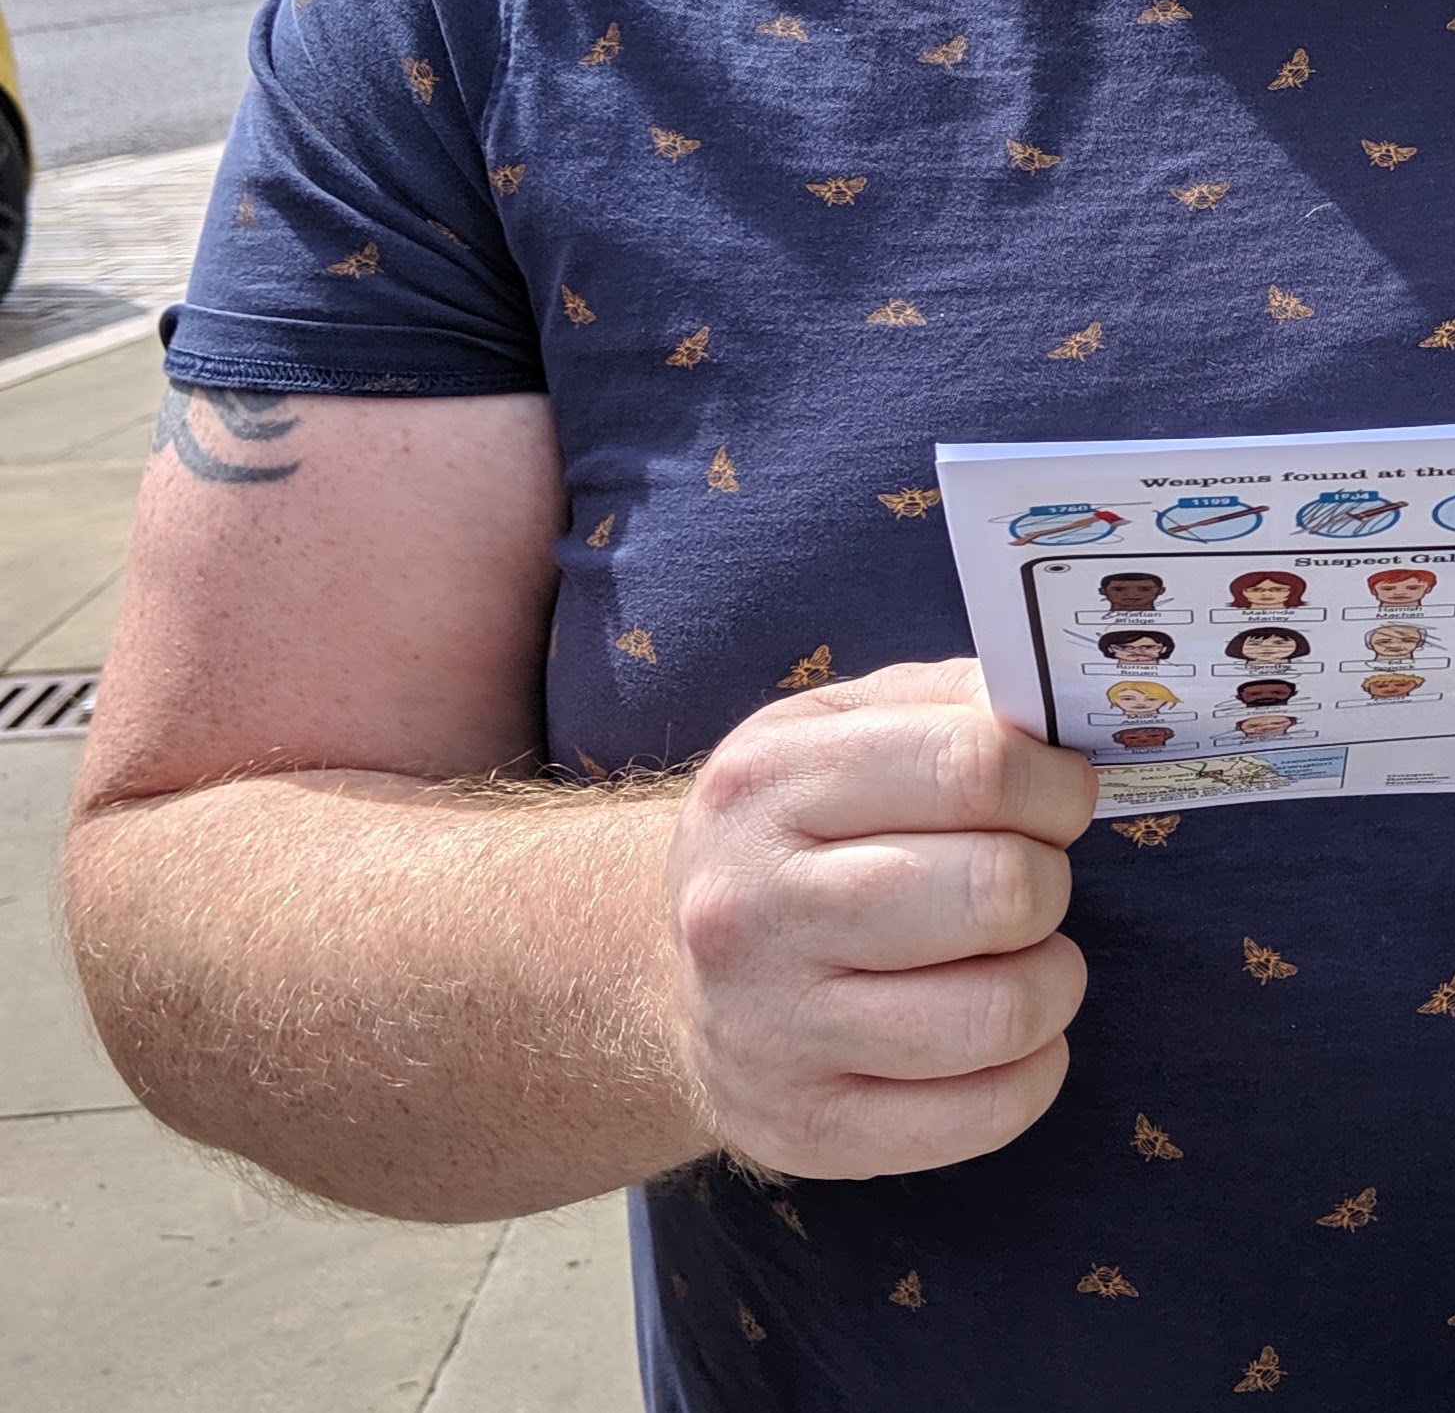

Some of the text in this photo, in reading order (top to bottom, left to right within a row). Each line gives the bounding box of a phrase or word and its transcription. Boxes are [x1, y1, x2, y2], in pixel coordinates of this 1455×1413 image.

[1140, 473, 1272, 488] Weapons
[1281, 469, 1368, 483] found
[1377, 468, 1405, 479] at
[1191, 498, 1231, 506] 1199
[1294, 554, 1402, 569] Suspect
